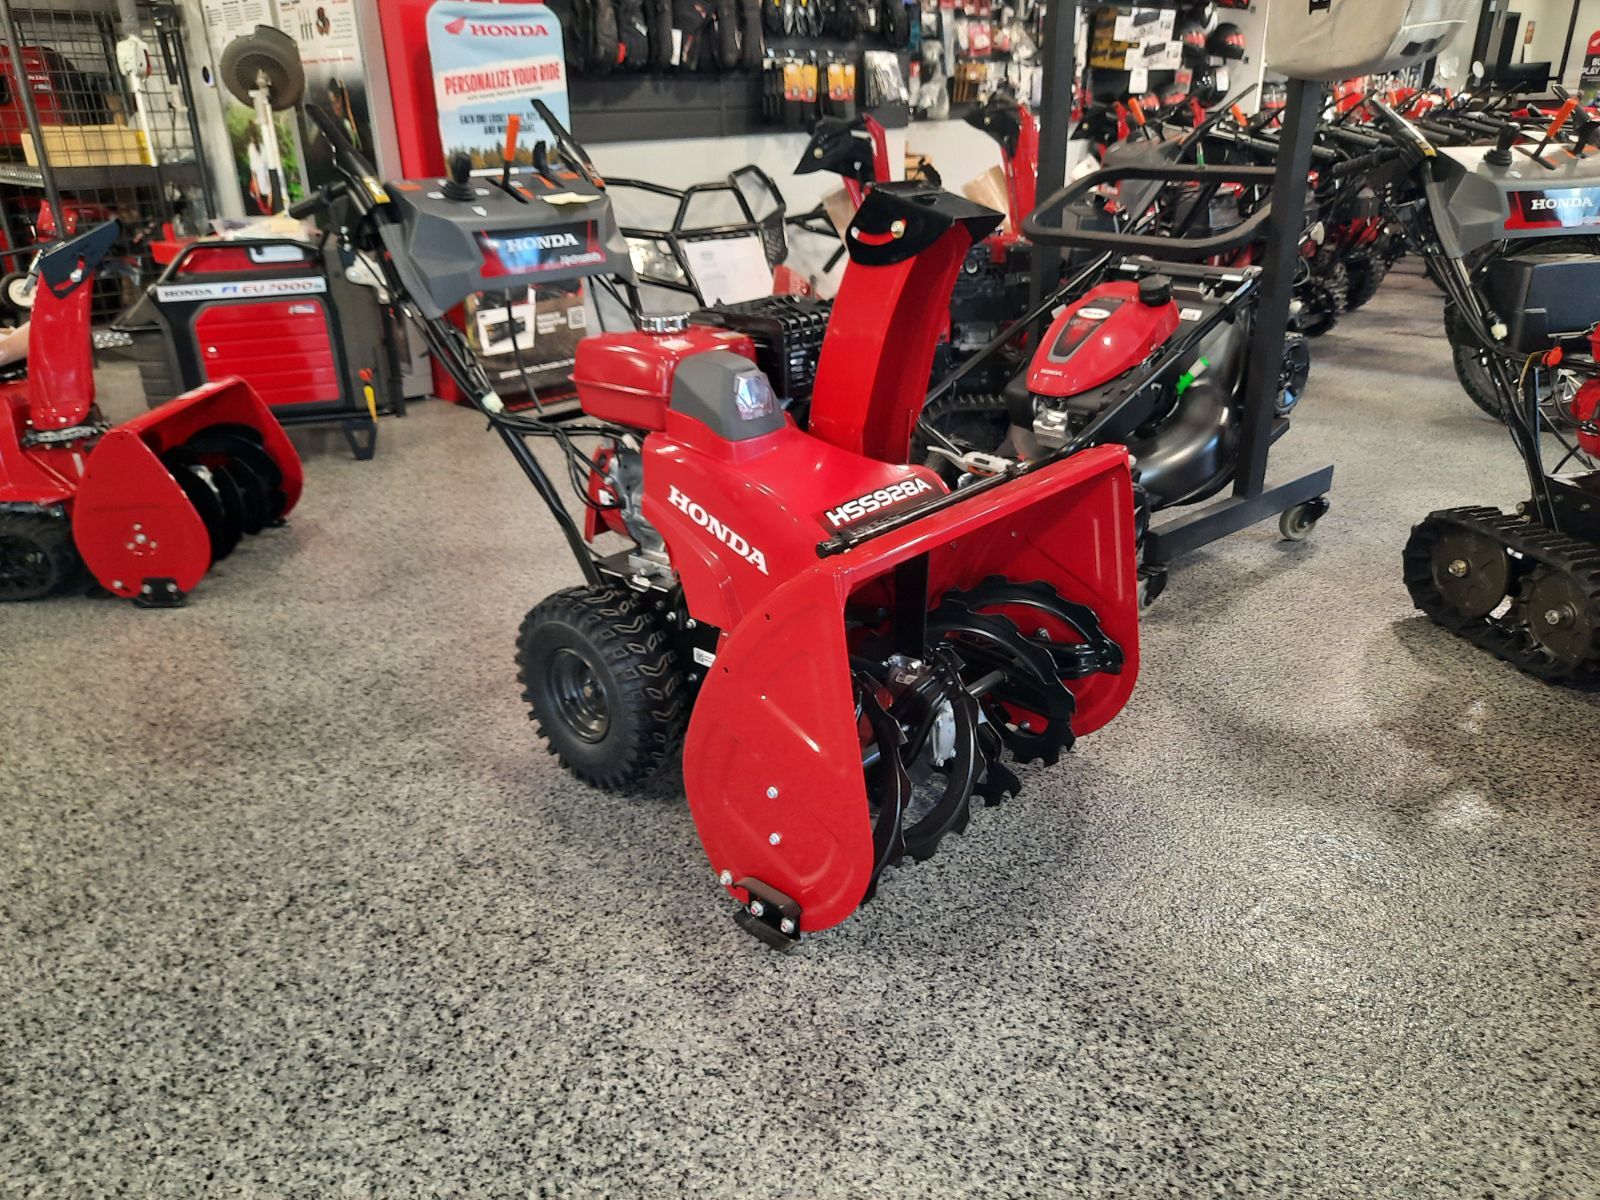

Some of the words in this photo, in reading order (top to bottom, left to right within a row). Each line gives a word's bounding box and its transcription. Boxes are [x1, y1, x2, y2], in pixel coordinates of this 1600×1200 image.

[470, 24, 549, 36] HONDA
[444, 69, 511, 96] PERSONALIZE
[512, 66, 539, 88] YOUR
[539, 62, 561, 82] RIDE
[1531, 197, 1593, 211] HONDA
[505, 233, 580, 252] HONDA
[164, 289, 213, 298] HONDA
[825, 477, 932, 527] HSS928A
[668, 485, 769, 576] HONDA
